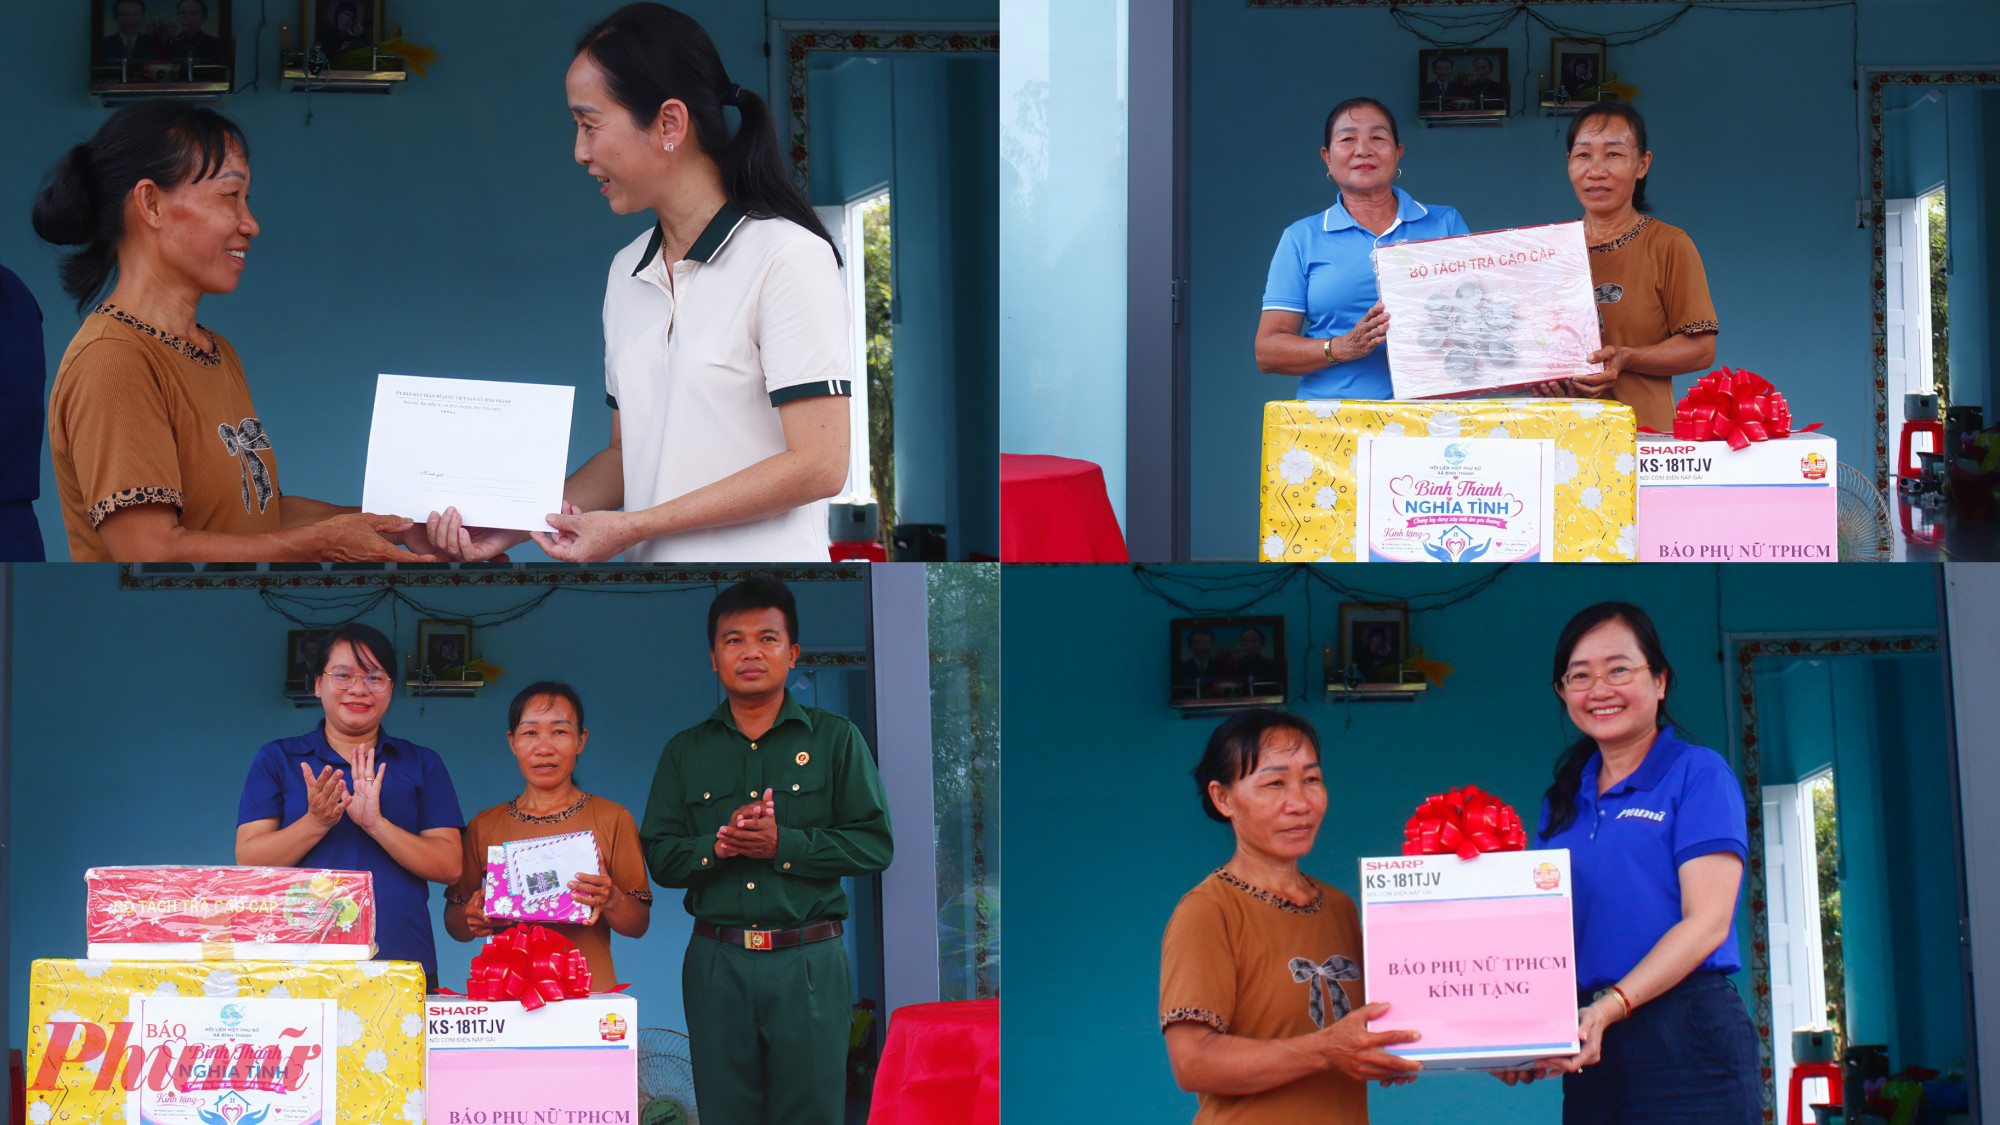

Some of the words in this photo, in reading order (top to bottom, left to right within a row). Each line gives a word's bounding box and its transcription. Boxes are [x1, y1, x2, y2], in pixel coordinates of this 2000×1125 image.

[1431, 259, 1466, 276] TÁCH
[1498, 252, 1527, 267] CAO
[1639, 445, 1696, 455] SHARP
[1639, 458, 1712, 473] KS-181TJV
[1415, 480, 1453, 496] Bình
[1457, 480, 1504, 496] Thành
[1467, 498, 1509, 515] TÌNH
[1659, 541, 1695, 558] BÁO
[1700, 544, 1735, 560] PHỤ
[1739, 542, 1766, 558] NỮ
[1769, 544, 1831, 558] TPHCM
[1366, 860, 1424, 871] SHARP
[1366, 872, 1441, 889] KS-181TJV
[138, 897, 177, 914] TÁCH
[1388, 959, 1426, 976] BÁO
[1431, 960, 1466, 977] PHỤ
[1472, 956, 1500, 972] NỮ
[1503, 956, 1567, 972] TPHCM
[1429, 981, 1474, 998] KÍNH
[1479, 981, 1530, 999] TẶNG
[429, 1006, 488, 1016] SHARP
[429, 1019, 506, 1035] KS-181TJV
[449, 1108, 487, 1125] BÁO
[534, 1108, 562, 1124] NỮ
[565, 1110, 631, 1124] TPHCM
